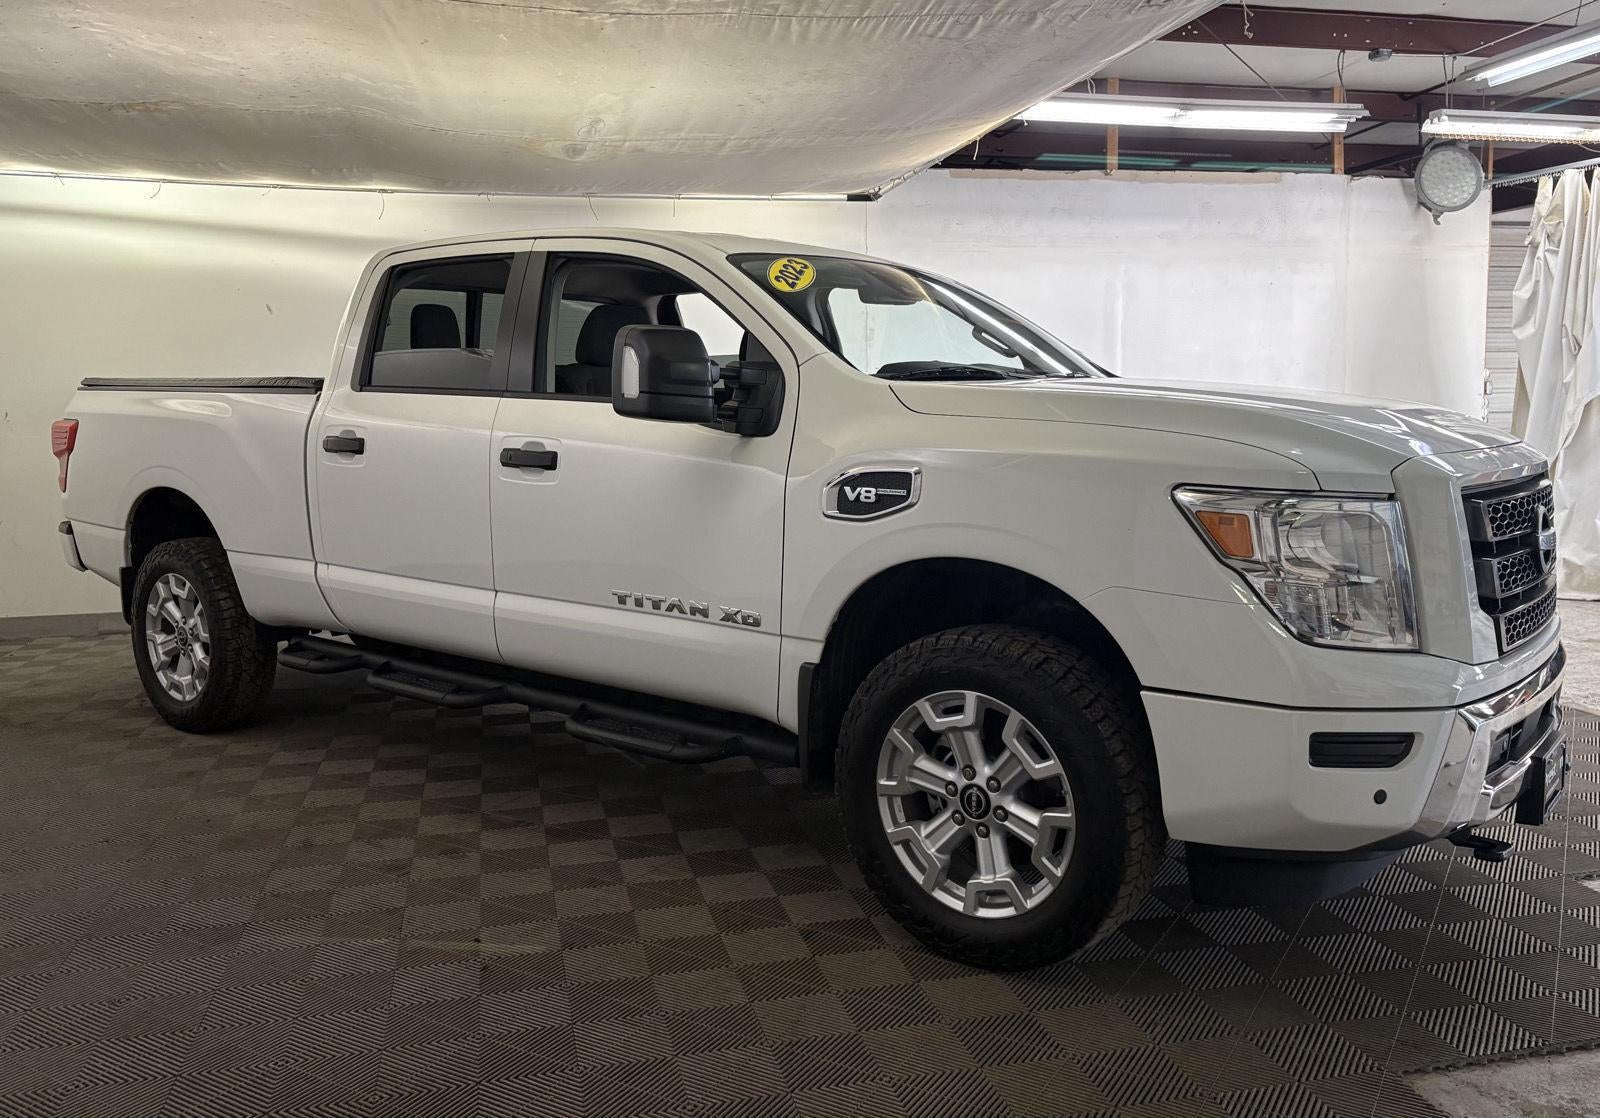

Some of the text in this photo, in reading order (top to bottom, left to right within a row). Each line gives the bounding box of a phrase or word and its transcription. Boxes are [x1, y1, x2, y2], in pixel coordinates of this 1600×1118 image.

[774, 259, 809, 289] 2023
[843, 486, 877, 503] V8
[611, 589, 762, 628] TITAN XD
